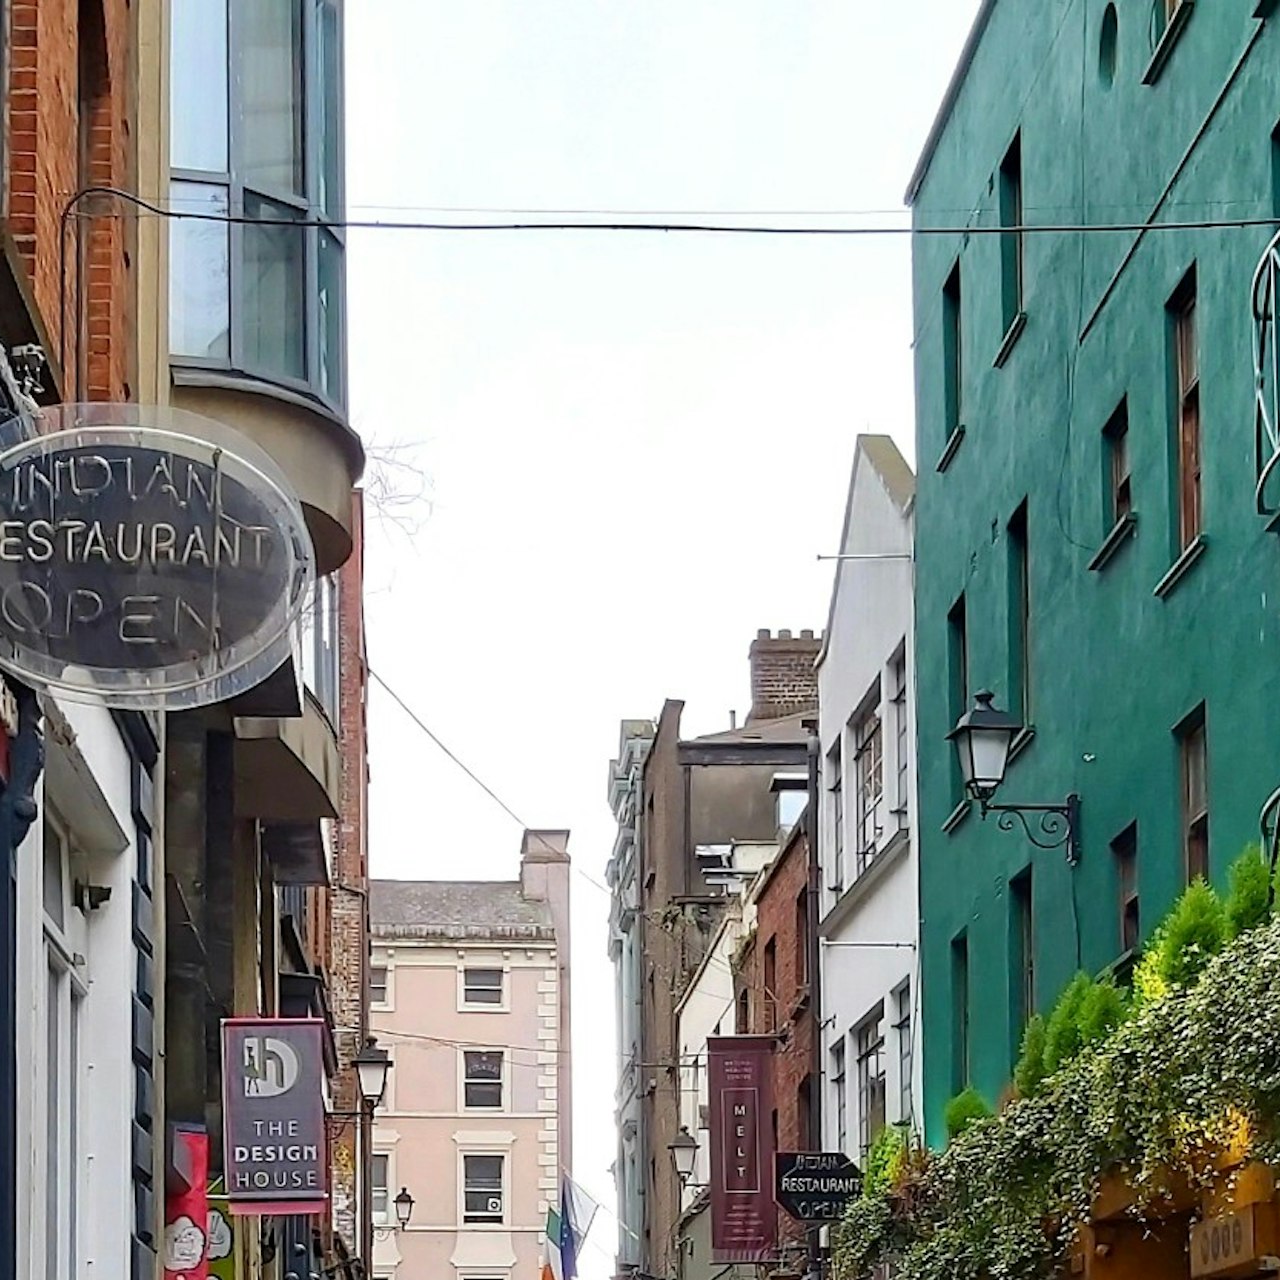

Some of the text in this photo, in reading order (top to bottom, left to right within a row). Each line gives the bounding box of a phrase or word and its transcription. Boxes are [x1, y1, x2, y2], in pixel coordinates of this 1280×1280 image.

[10, 453, 220, 514] INDIAN
[1, 580, 219, 647] OPEN
[253, 1120, 299, 1137] THE
[733, 1104, 747, 1178] MELT
[234, 1145, 318, 1162] DESIGN
[235, 1170, 318, 1188] HOUSE
[781, 1177, 860, 1193] RESTAURANT
